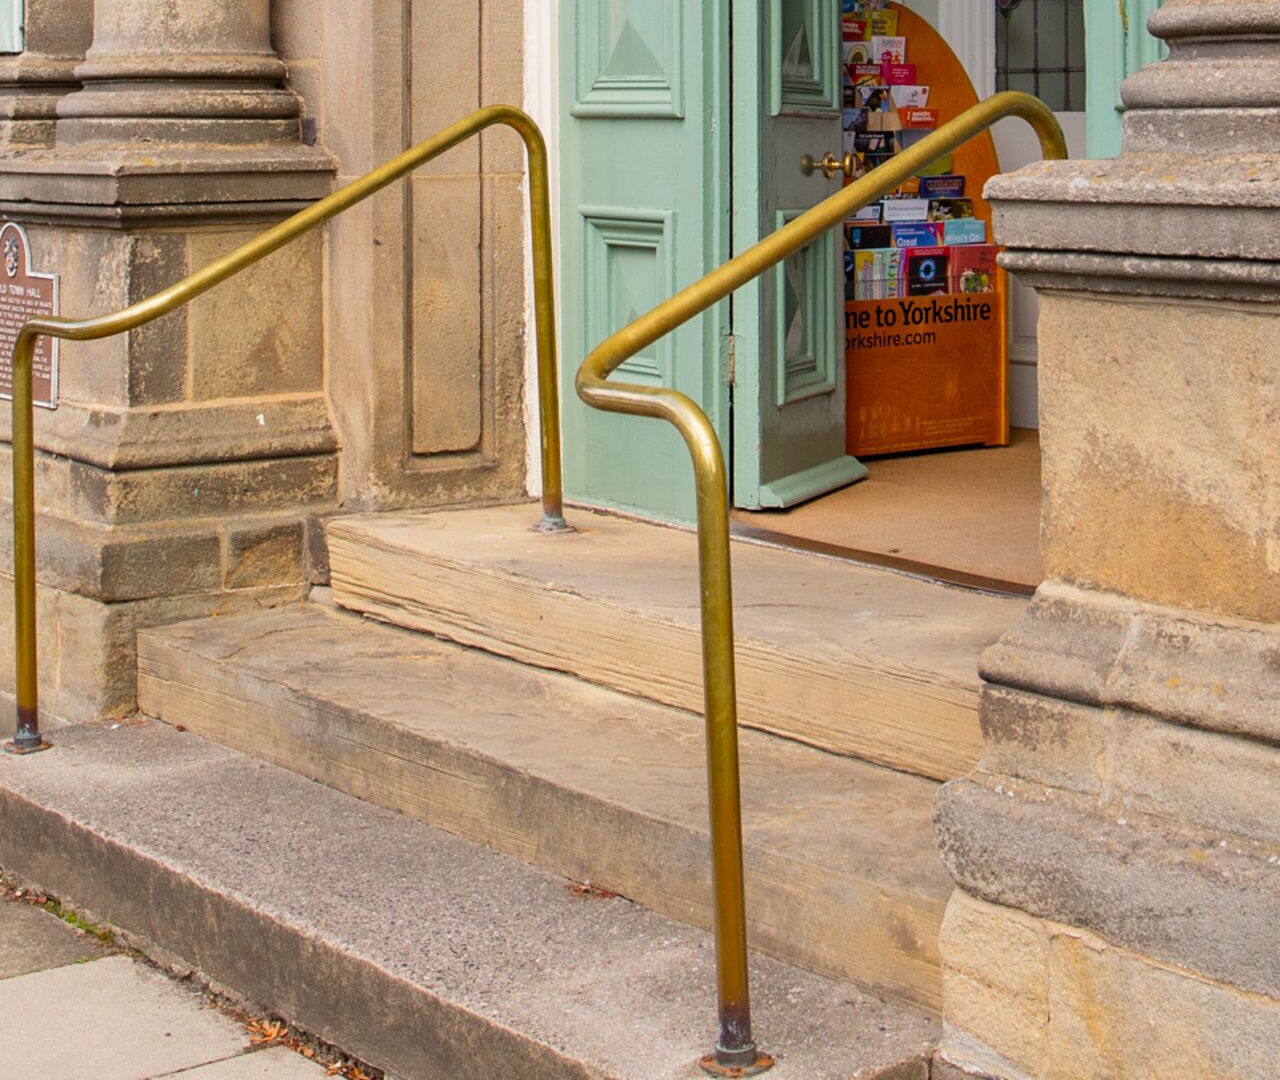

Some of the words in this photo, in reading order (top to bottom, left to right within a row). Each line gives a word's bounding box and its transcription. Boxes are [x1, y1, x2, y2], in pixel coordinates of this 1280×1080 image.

[26, 288, 40, 298] HALL
[875, 305, 896, 327] to
[899, 297, 991, 325] Yorkshire
